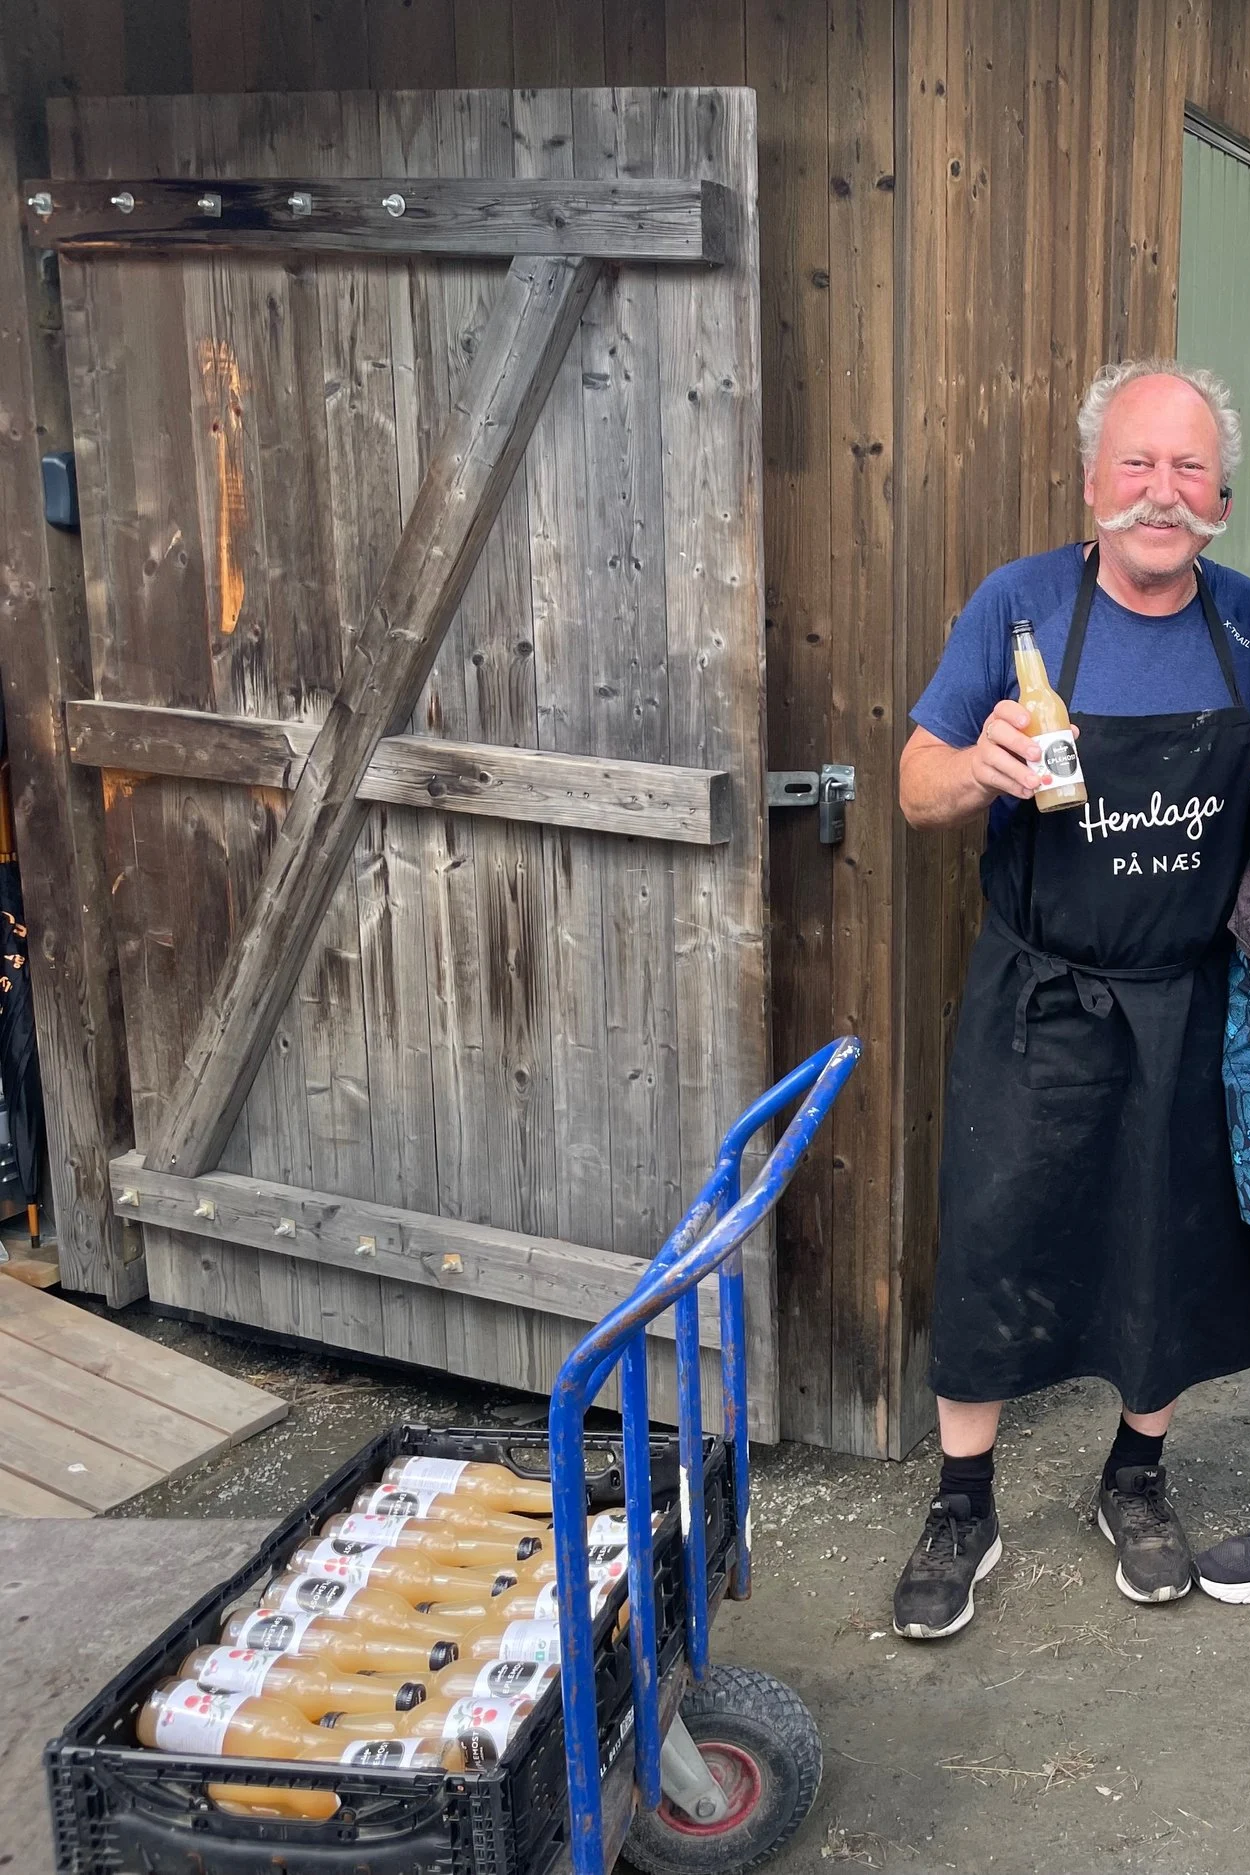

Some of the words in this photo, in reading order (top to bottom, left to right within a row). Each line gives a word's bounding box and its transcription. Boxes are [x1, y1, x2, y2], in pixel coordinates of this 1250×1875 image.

[1223, 620, 1250, 649] X-TRAIL
[1078, 790, 1225, 843] Hemlaga
[1113, 852, 1143, 875] PÅ
[1152, 851, 1201, 874] NÆS
